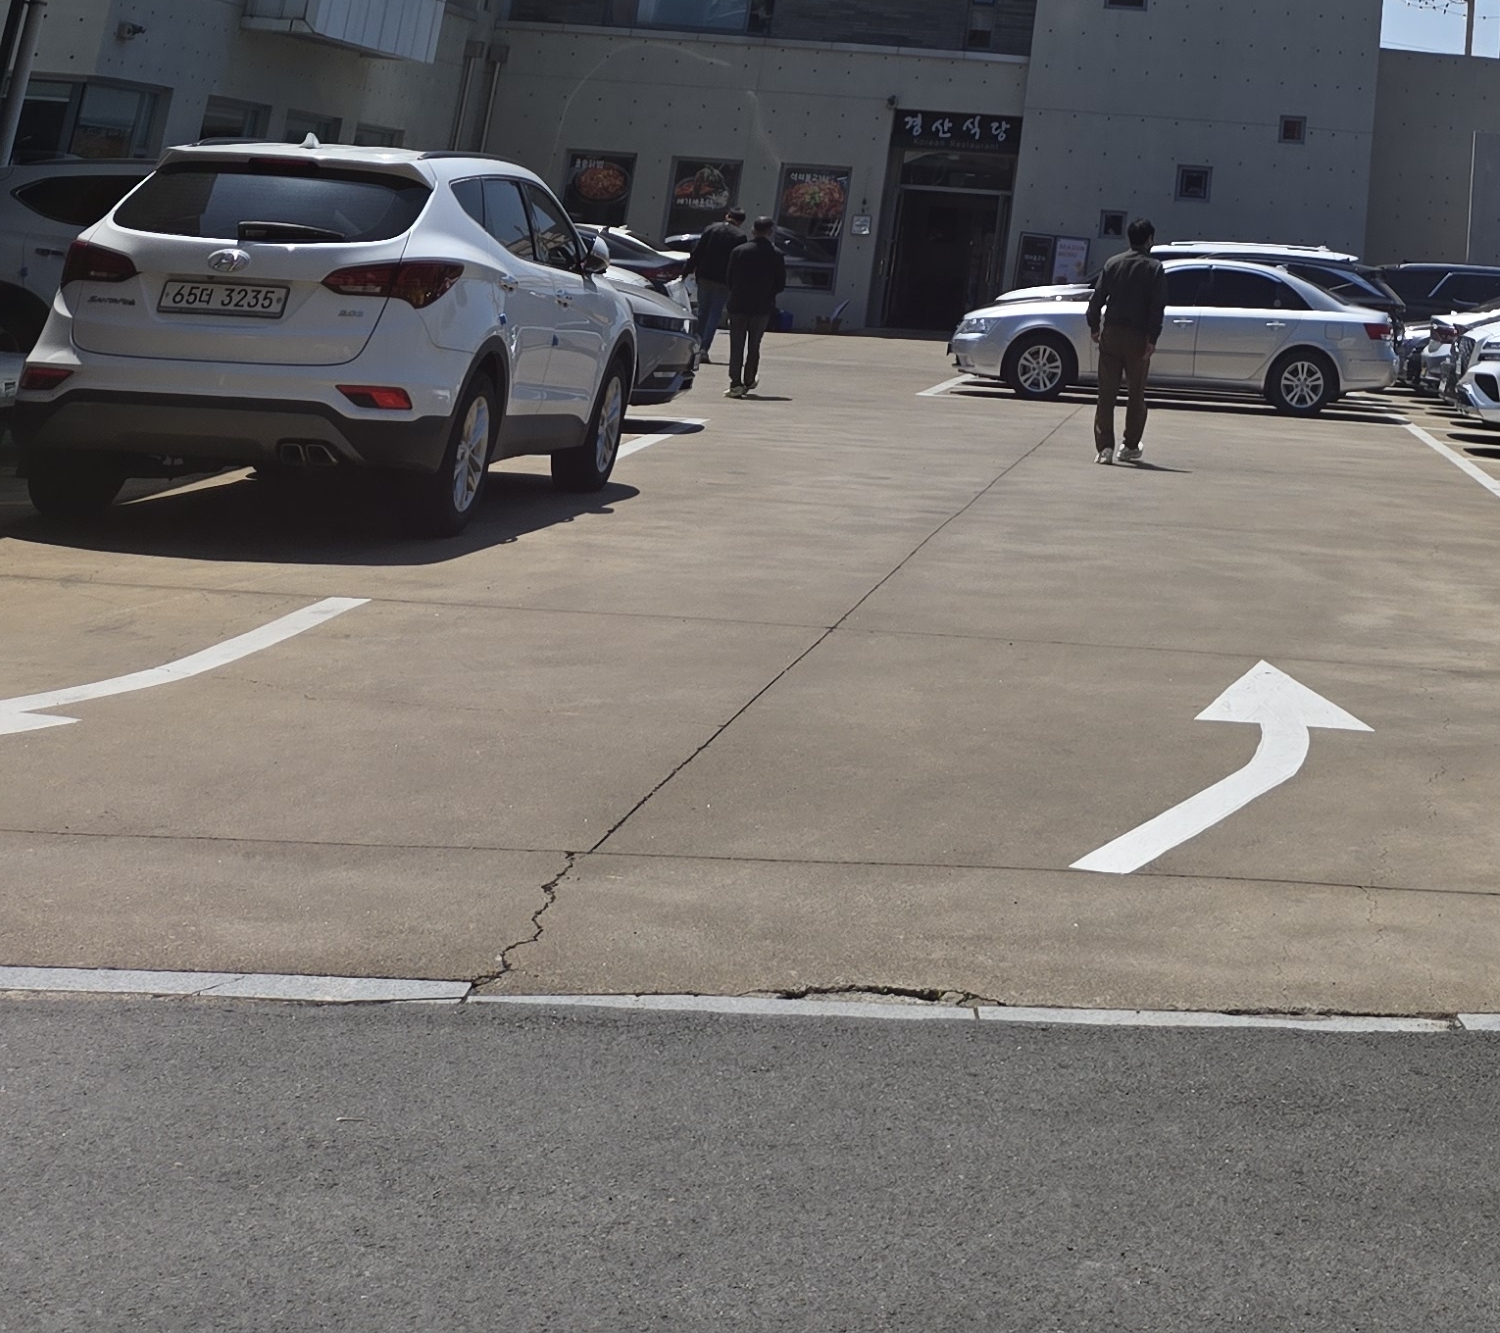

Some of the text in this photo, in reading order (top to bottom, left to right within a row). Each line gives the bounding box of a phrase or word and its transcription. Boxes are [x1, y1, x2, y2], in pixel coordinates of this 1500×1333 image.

[904, 112, 1011, 141] 경산식당
[172, 285, 275, 309] 65더 3235
